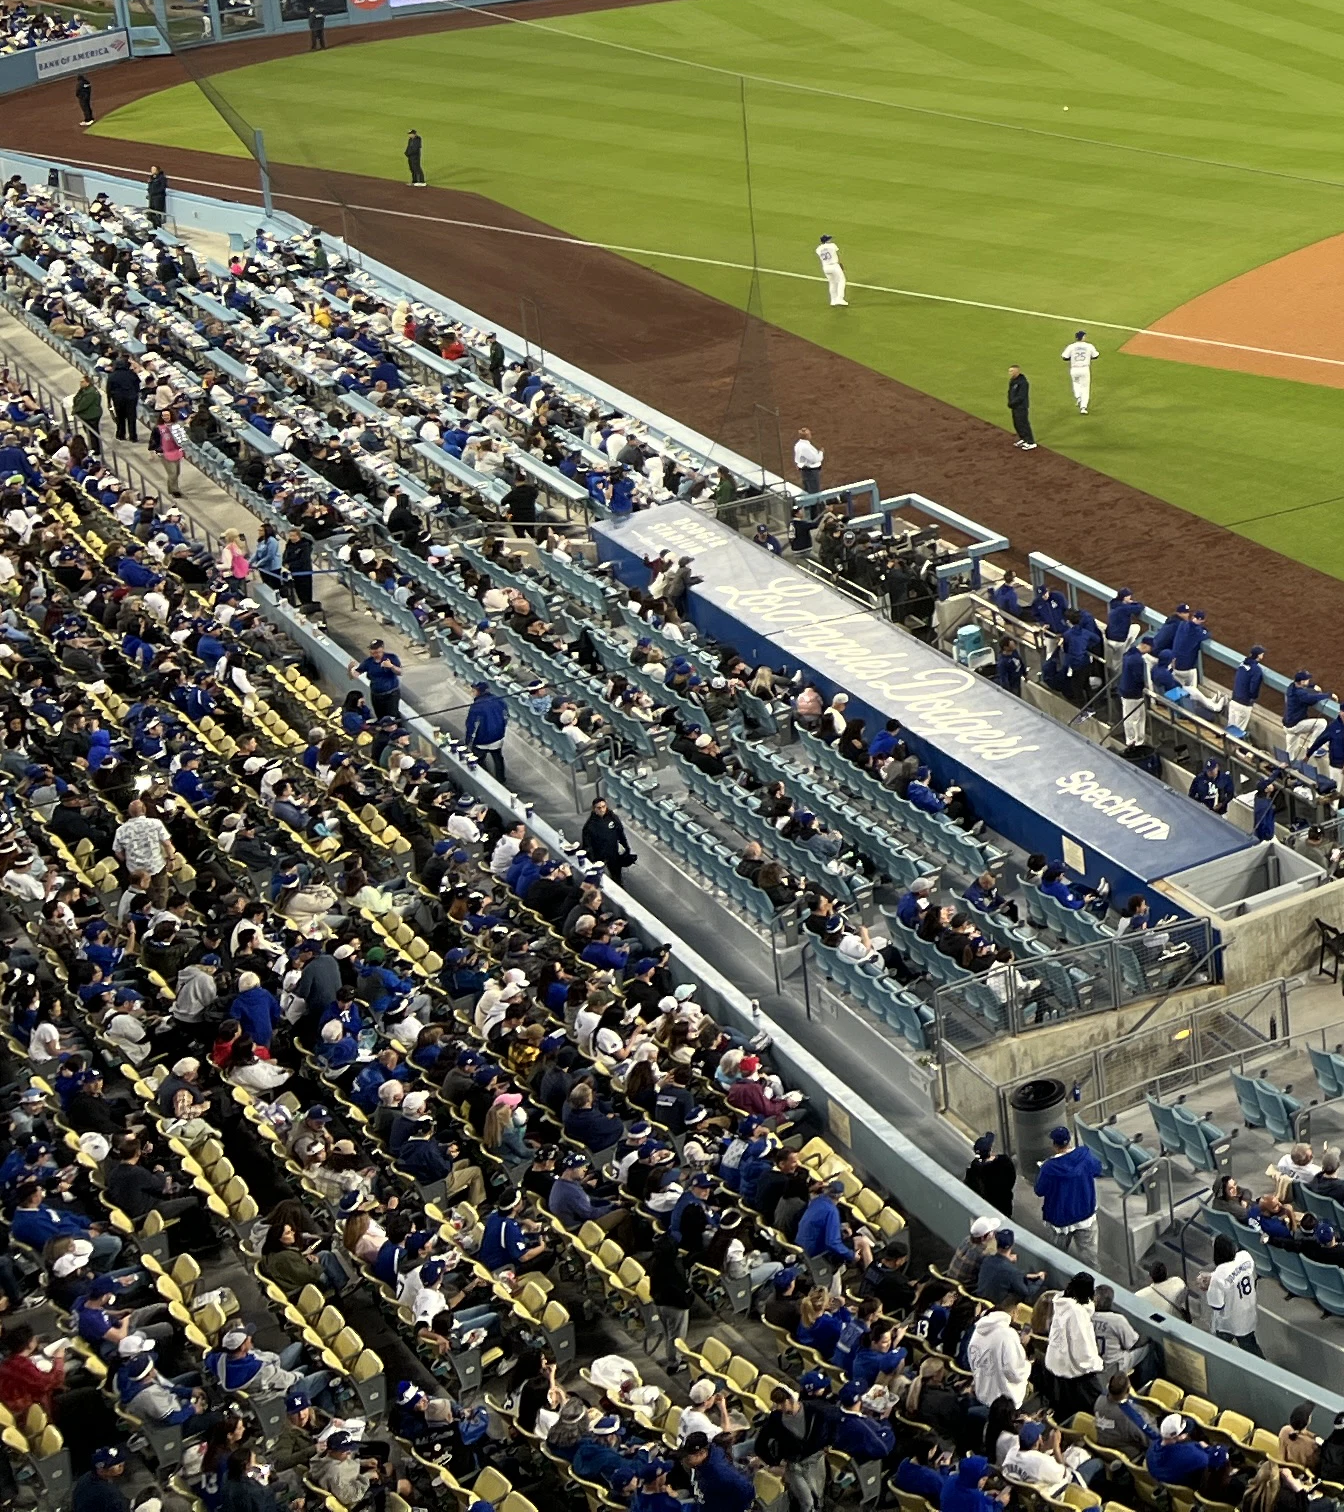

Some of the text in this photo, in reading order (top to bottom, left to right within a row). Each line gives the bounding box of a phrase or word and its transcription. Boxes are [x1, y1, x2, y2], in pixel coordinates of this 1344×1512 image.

[38, 47, 110, 72] BANK OF AMERICA
[867, 668, 1038, 761] Dodgers
[1055, 768, 1168, 841] Spectrum
[1236, 1275, 1252, 1300] 18
[916, 1319, 930, 1338] 13
